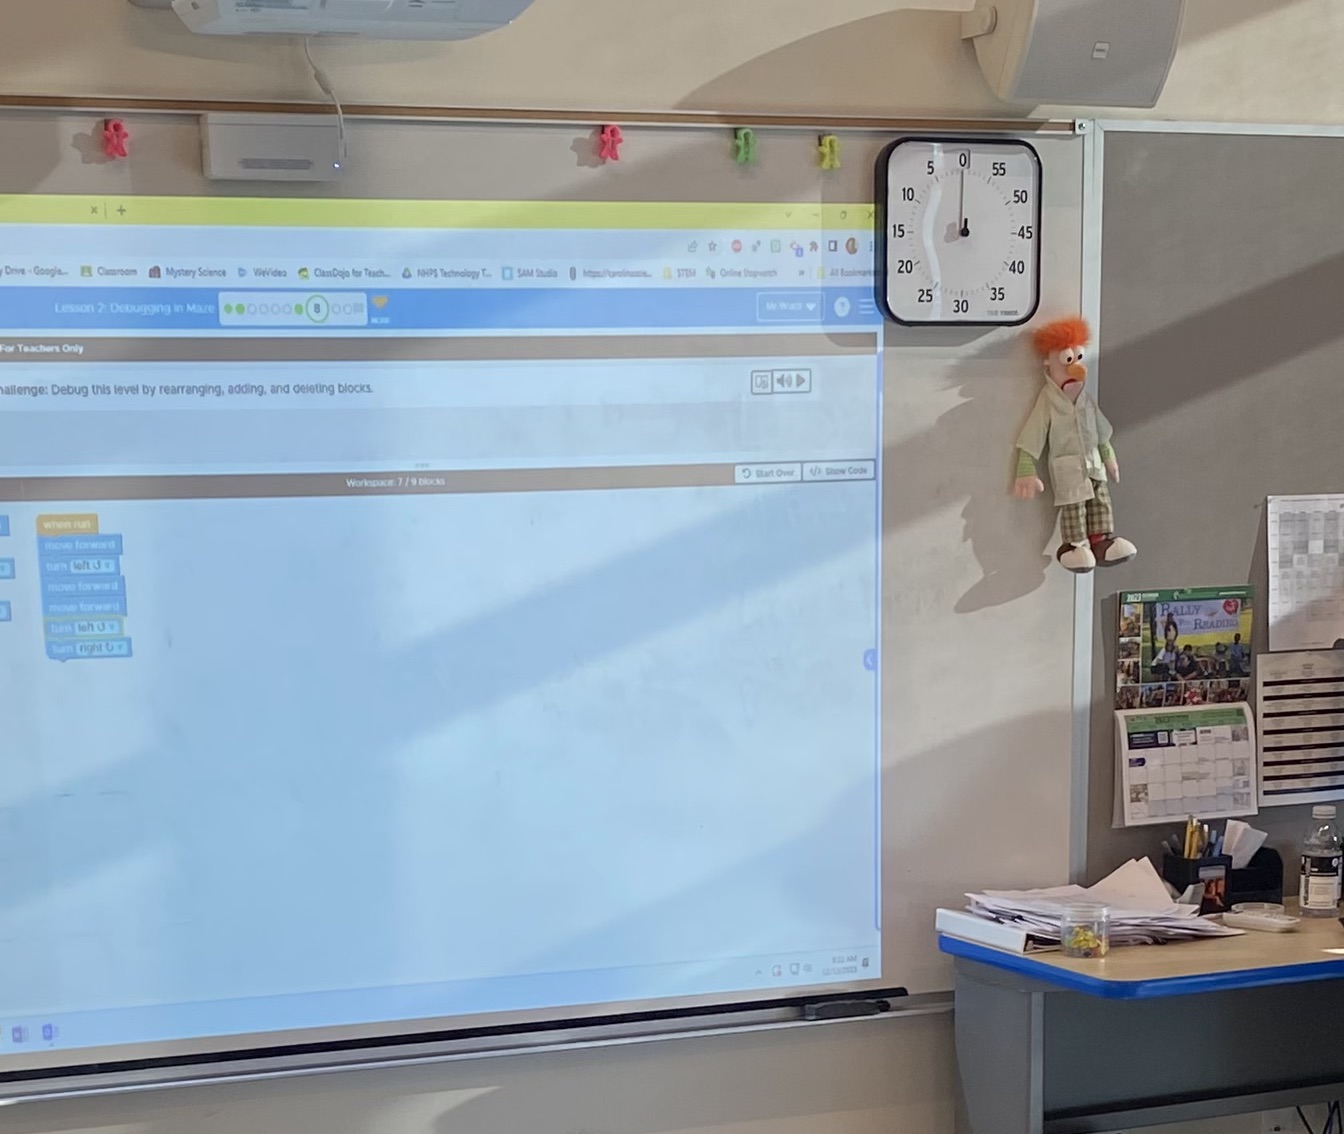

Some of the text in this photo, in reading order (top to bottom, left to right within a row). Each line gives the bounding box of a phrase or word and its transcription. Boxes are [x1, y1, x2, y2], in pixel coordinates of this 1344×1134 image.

[958, 152, 967, 168] 0
[927, 160, 935, 175] 5
[992, 162, 1006, 177] 55
[902, 187, 915, 201] 10
[1013, 189, 1028, 204] 50
[892, 223, 905, 238] 15
[1017, 225, 1033, 240] 45
[4, 266, 26, 276] Drive
[97, 267, 137, 277] Classroom
[165, 267, 227, 279] Mystery Science
[253, 268, 287, 278] WeVideo
[897, 259, 913, 274] 20
[1008, 260, 1025, 274] 40
[917, 288, 933, 303] 25
[989, 287, 1005, 301] 35
[55, 302, 95, 314] Lesson
[110, 302, 171, 317] Debugging
[173, 303, 184, 314] in
[186, 303, 215, 314] Maze
[953, 299, 969, 313] 30
[17, 344, 61, 353] Teachers
[62, 344, 84, 355] Only
[51, 384, 89, 397] Debug
[91, 384, 111, 396] this
[113, 384, 139, 395] level
[141, 384, 156, 397] by
[159, 384, 225, 398] rearranging,
[227, 384, 267, 397] adding,
[270, 384, 290, 395] and
[292, 383, 335, 396] deleting
[337, 382, 374, 394] blocks.
[755, 469, 795, 478] Start Over
[847, 466, 868, 475] Code
[418, 476, 446, 486] blocks
[43, 520, 91, 530] when run
[44, 540, 115, 550] move forward
[73, 560, 91, 571] left
[47, 581, 119, 592] move forward
[49, 602, 120, 613] move forward
[77, 622, 95, 633] left
[79, 641, 103, 655] right
